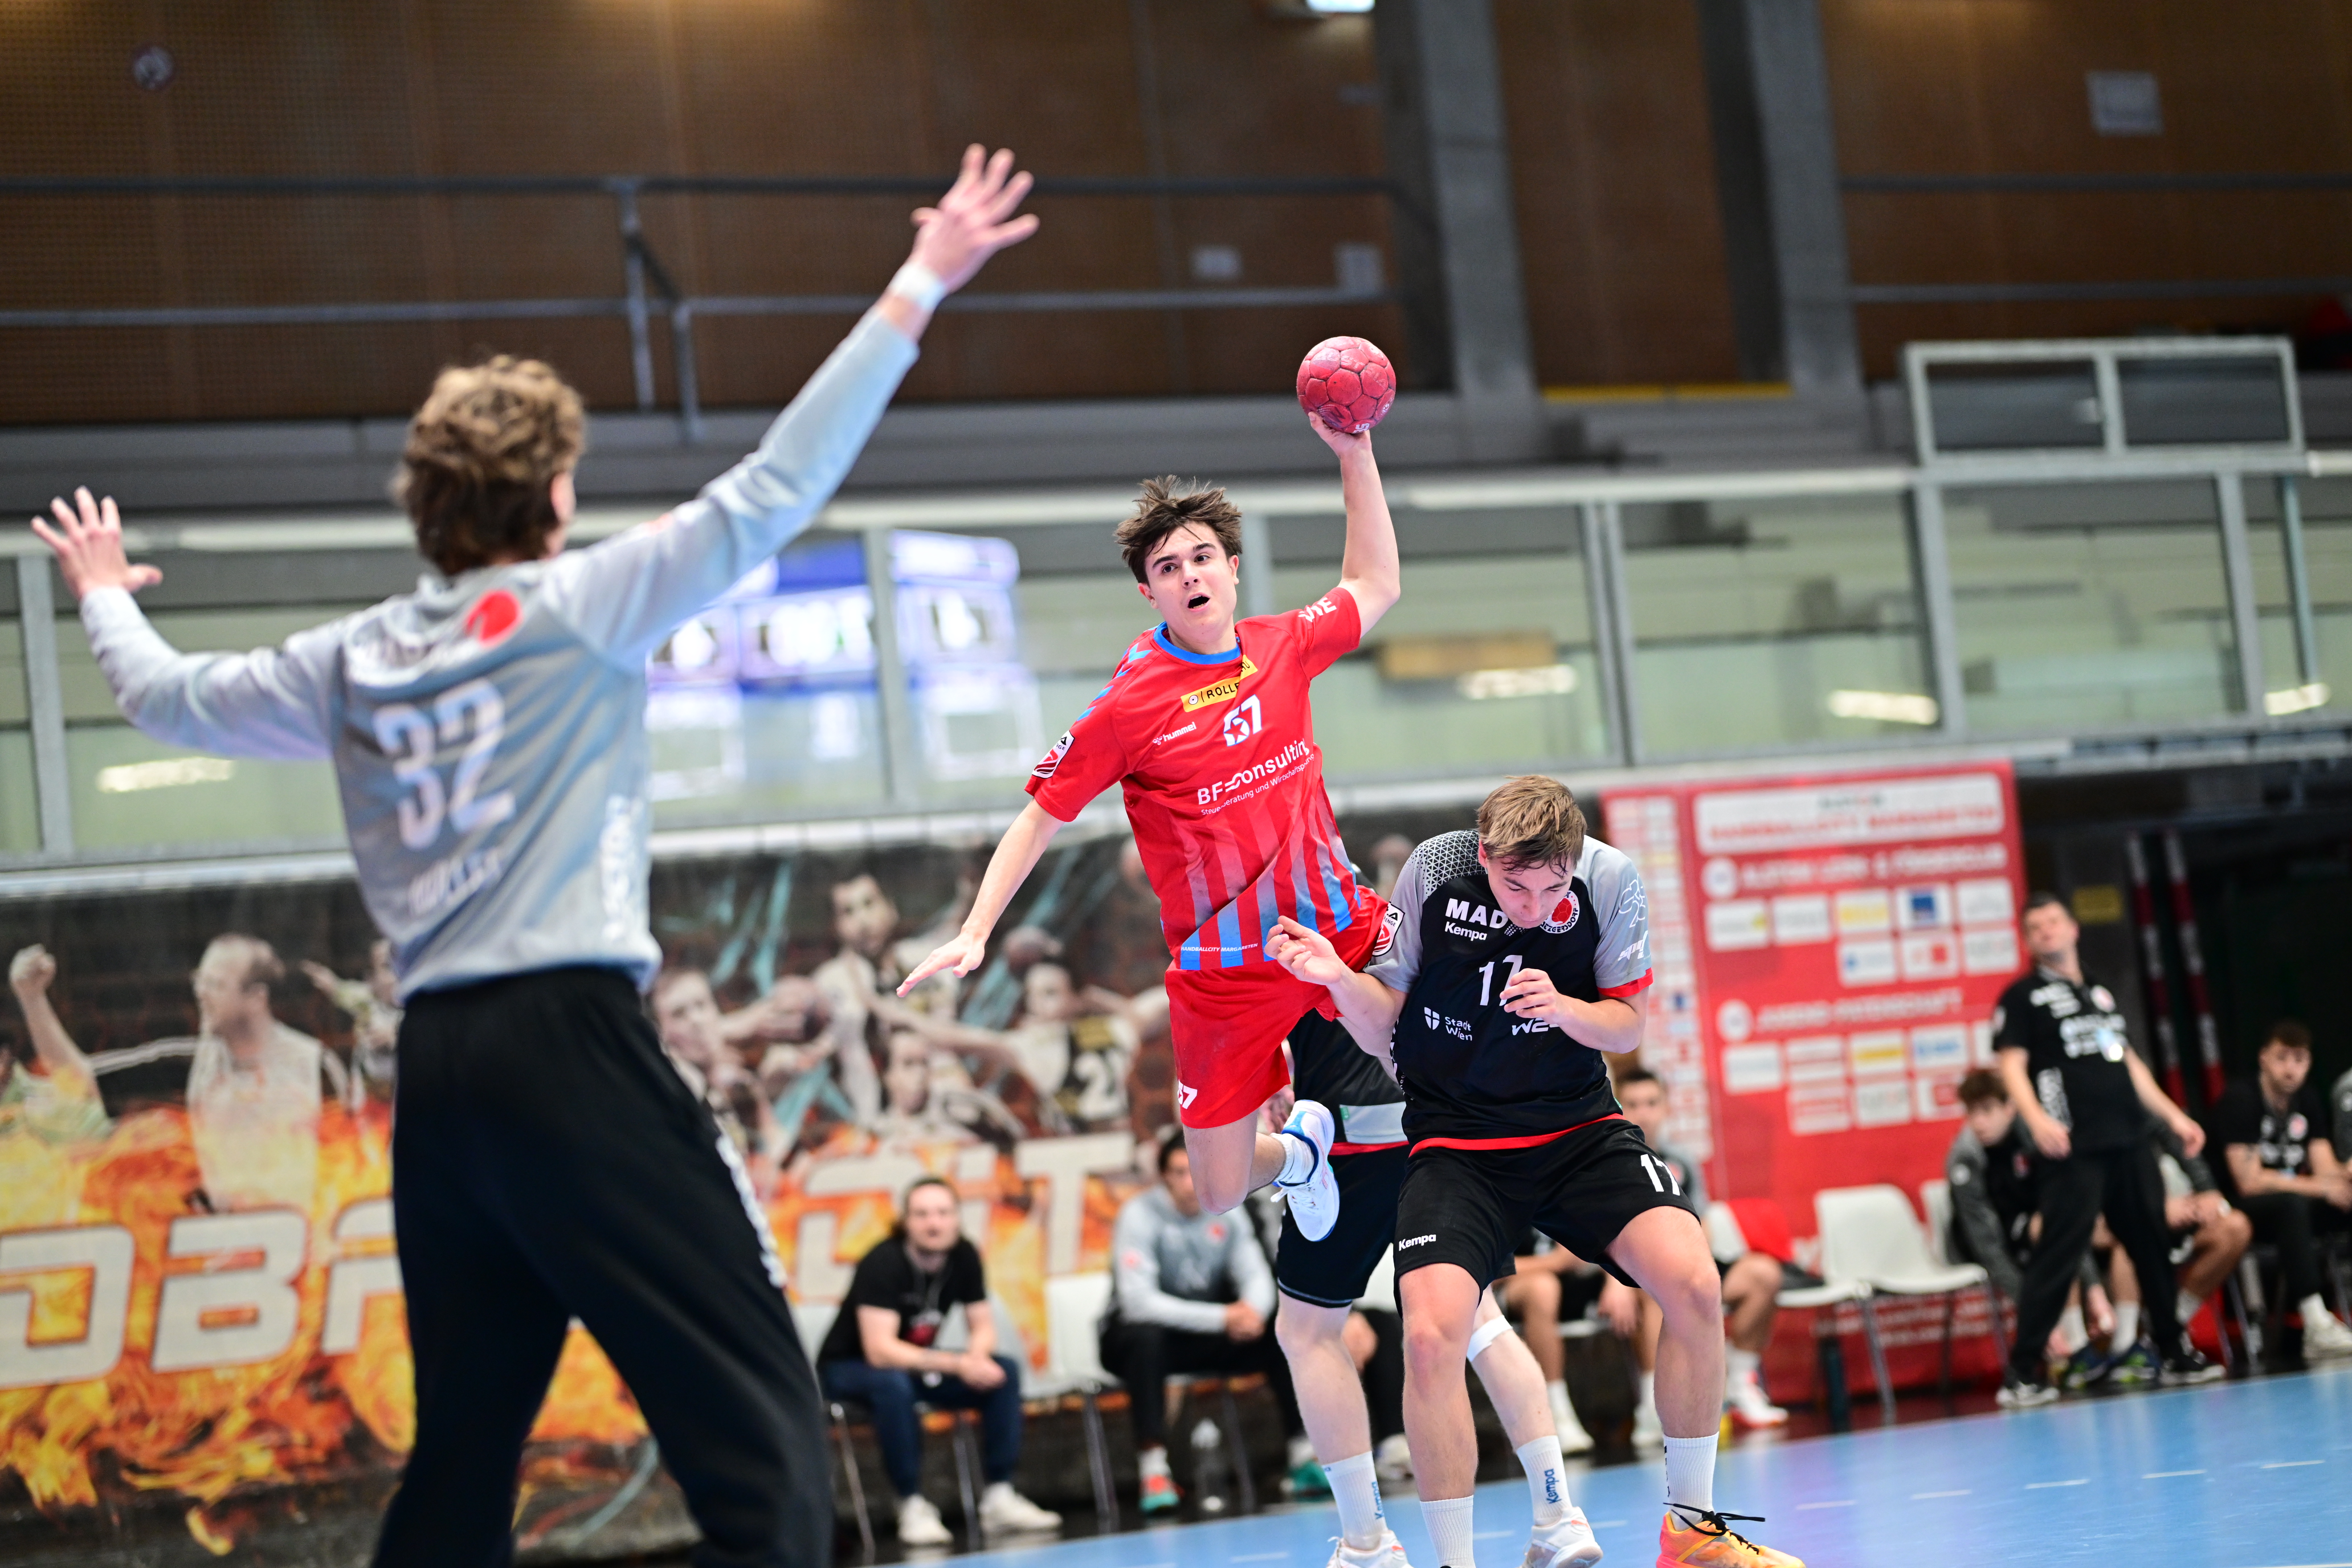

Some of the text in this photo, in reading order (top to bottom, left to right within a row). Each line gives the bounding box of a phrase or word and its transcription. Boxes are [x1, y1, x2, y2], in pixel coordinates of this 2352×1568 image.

[1223, 694, 1262, 746] 57
[1162, 721, 1197, 742] hummel
[371, 677, 517, 851] 32
[1255, 781, 1269, 794] und
[1444, 921, 1488, 941] Kempa
[1220, 942, 1258, 952] MARGARETEN
[1479, 954, 1523, 1006] 17
[1445, 1016, 1472, 1031] Stadt
[1446, 1024, 1472, 1042] Wien
[1640, 1153, 1680, 1196] 17
[1398, 1234, 1436, 1251] Kempa
[1544, 1468, 1562, 1504] Kempa
